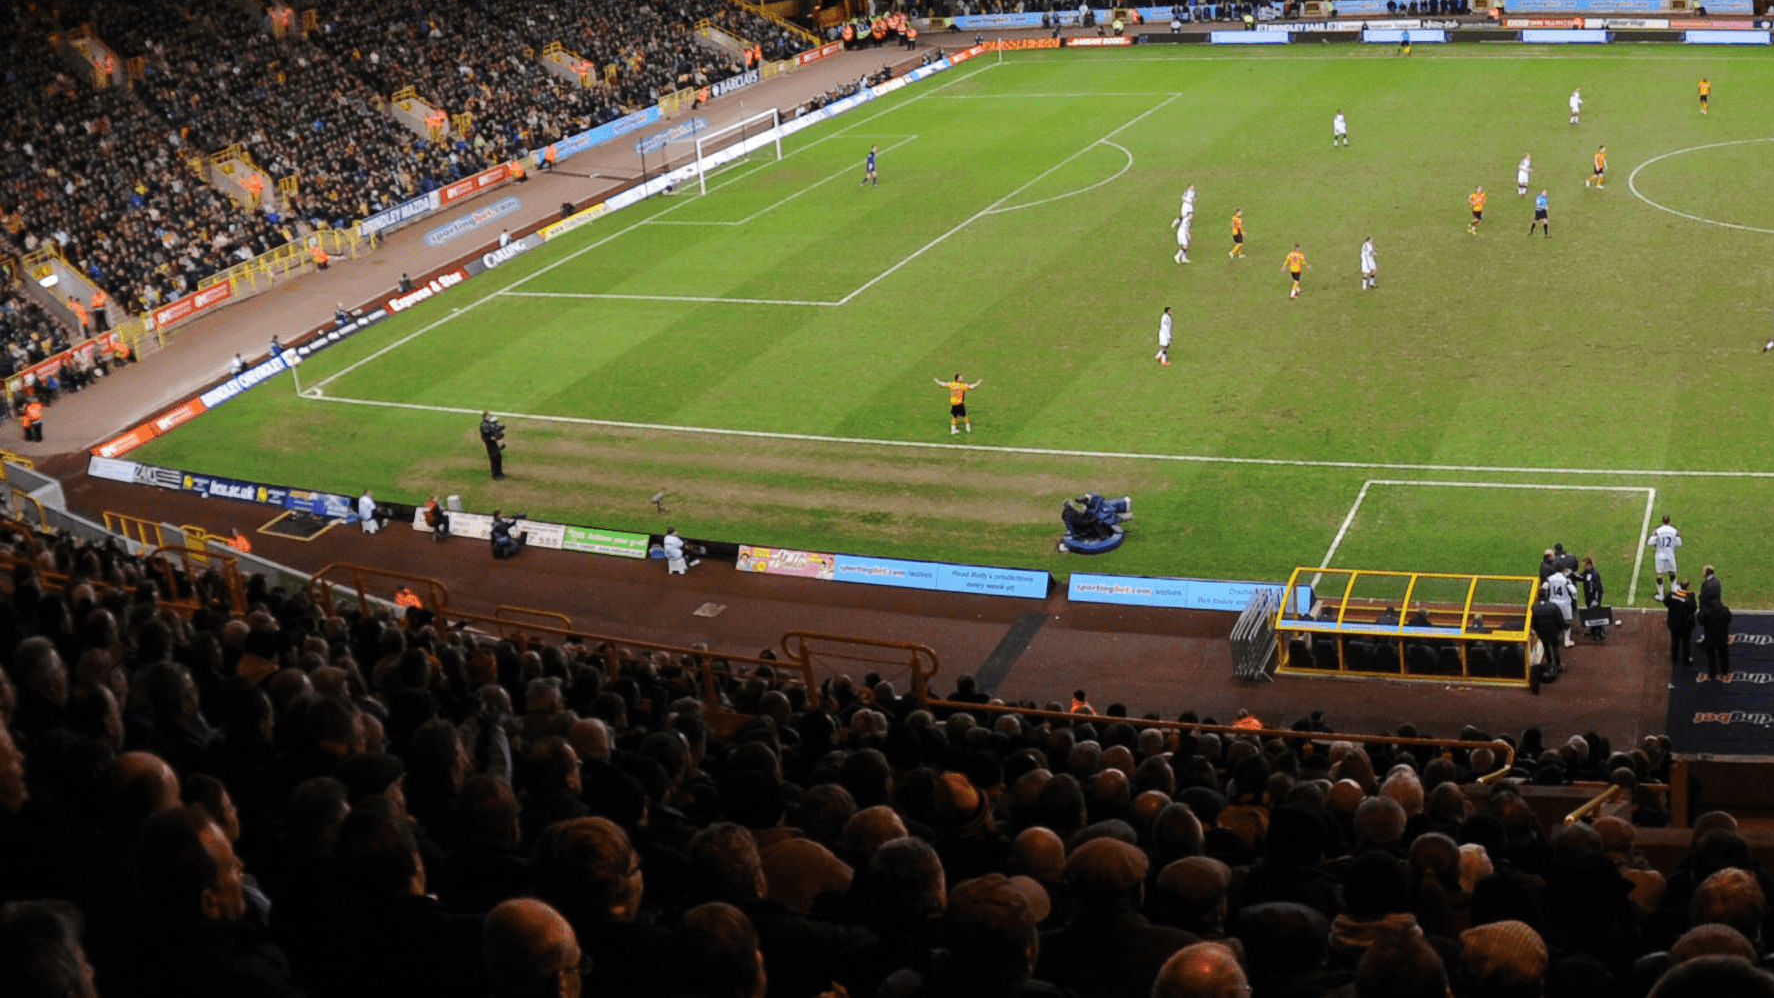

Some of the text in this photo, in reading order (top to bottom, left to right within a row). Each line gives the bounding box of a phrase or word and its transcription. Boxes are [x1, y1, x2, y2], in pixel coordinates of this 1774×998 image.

[719, 71, 759, 94] BARCLAYS
[389, 286, 432, 312] Express
[438, 271, 463, 289] Star
[1662, 537, 1672, 548] 12
[1076, 583, 1152, 597] sportingbet.com
[1553, 585, 1564, 597] 14
